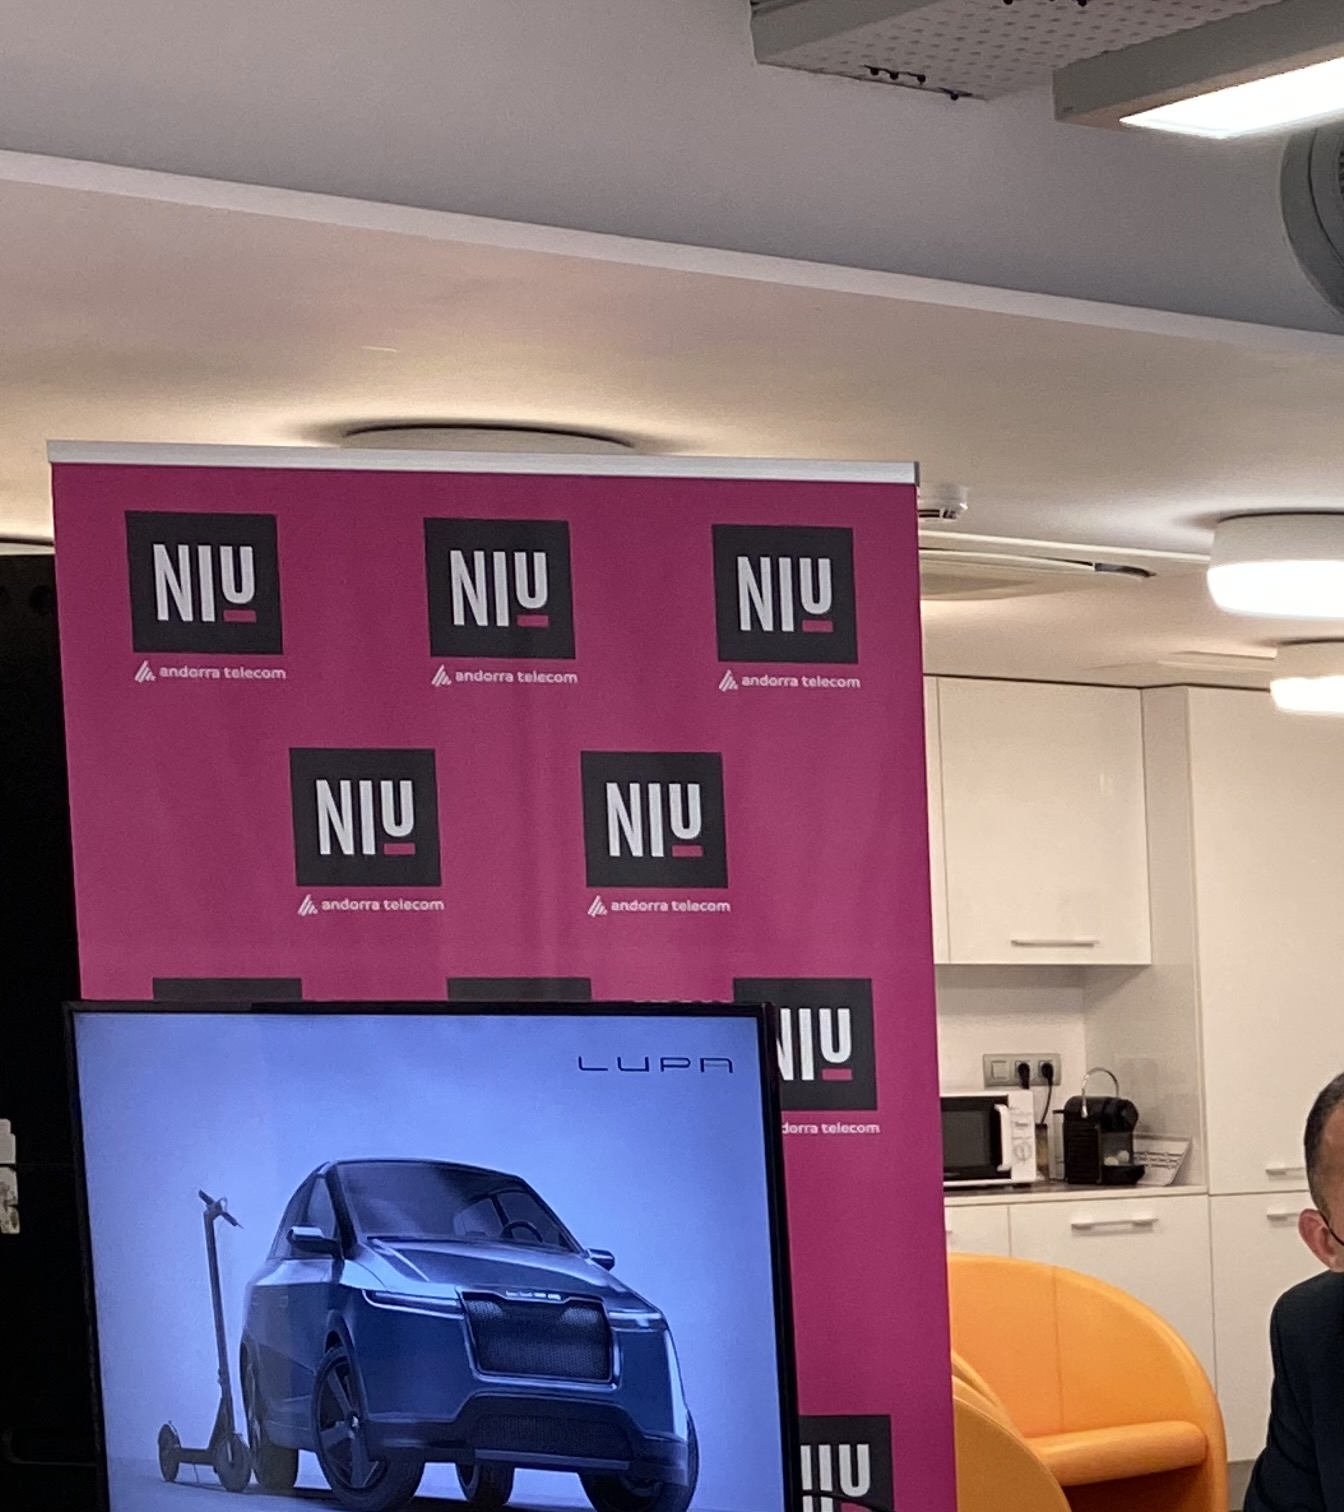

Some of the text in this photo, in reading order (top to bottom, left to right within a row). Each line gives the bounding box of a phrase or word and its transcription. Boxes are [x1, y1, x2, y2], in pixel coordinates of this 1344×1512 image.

[154, 544, 254, 622] NIU
[451, 551, 547, 626] NIU
[738, 557, 831, 632] NIU
[159, 665, 287, 680] andorra telecom
[455, 669, 578, 684] andorra telecom
[741, 674, 861, 689] andorra telecom
[316, 780, 414, 855] NIU
[607, 783, 701, 857] NIU
[321, 898, 445, 911] andorra telecom
[610, 899, 731, 912] andorra telecom
[781, 1121, 881, 1134] dorra telecom
